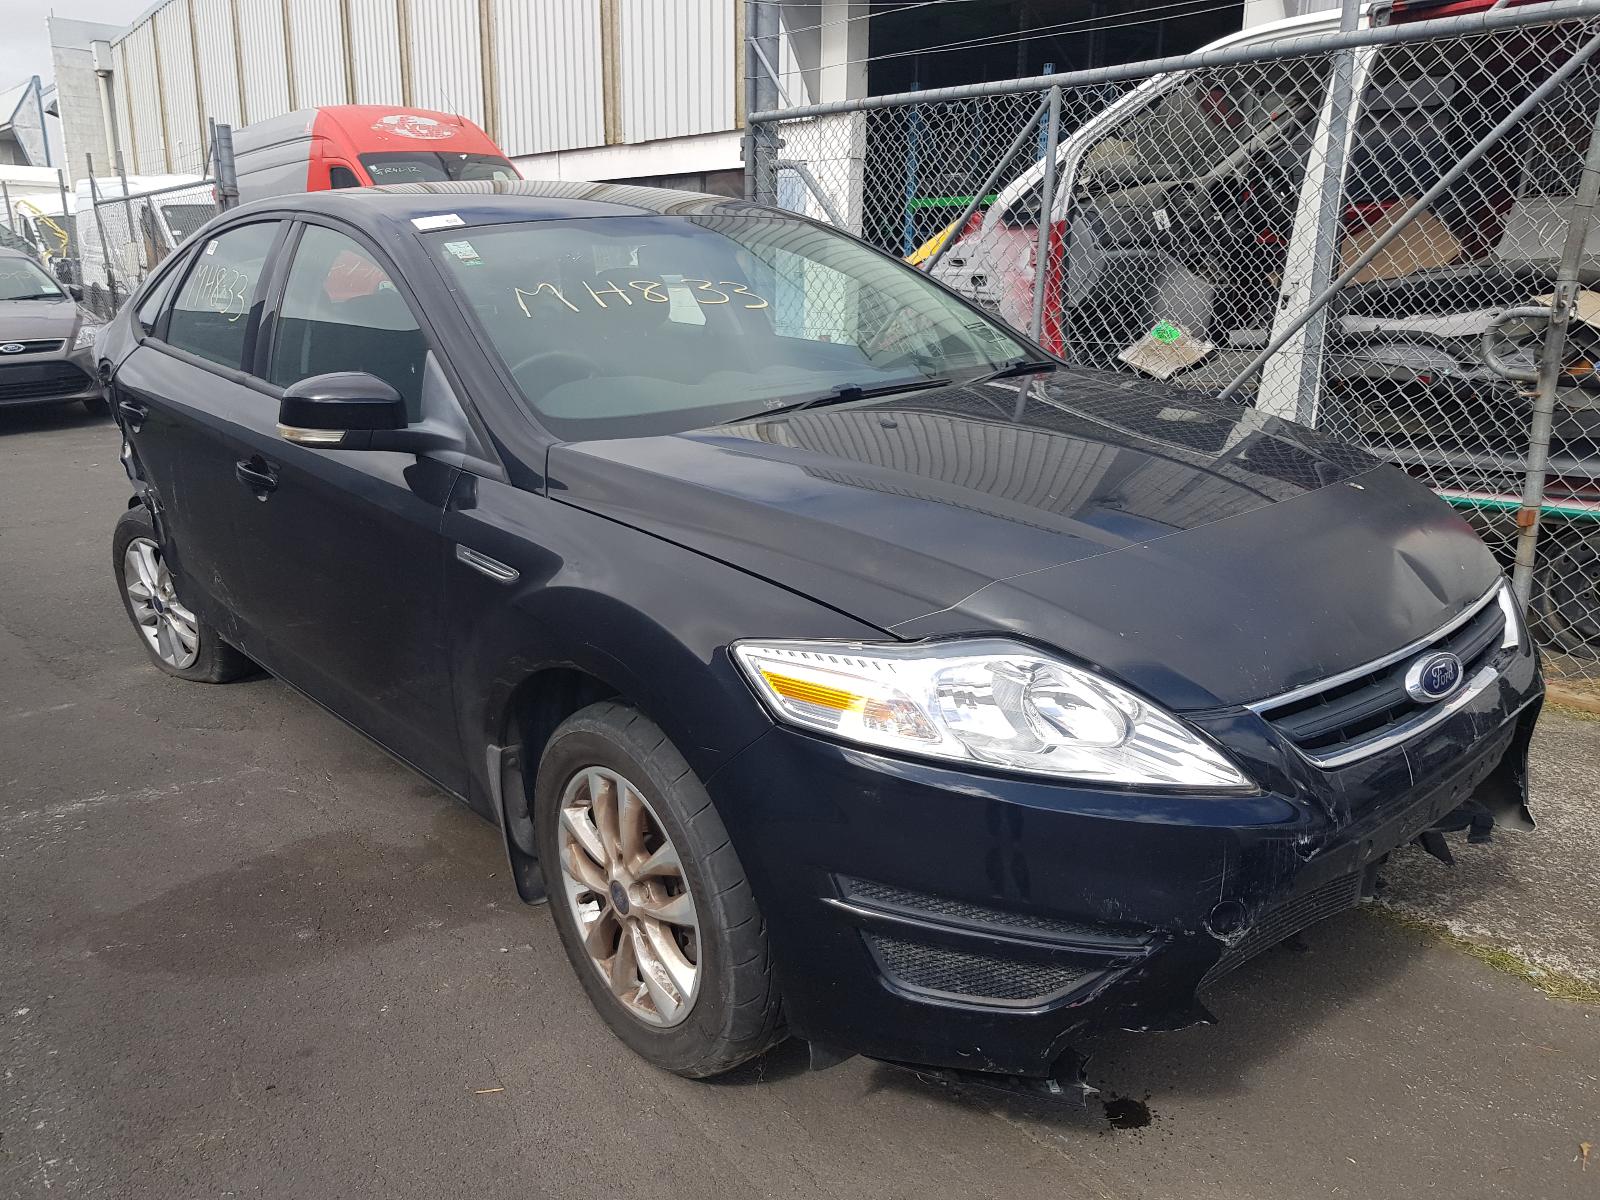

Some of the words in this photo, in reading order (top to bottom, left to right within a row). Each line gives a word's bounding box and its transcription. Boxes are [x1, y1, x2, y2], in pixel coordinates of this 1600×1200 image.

[185, 264, 249, 322] MH833
[514, 278, 769, 318] MH833
[1431, 662, 1455, 689] Ford
